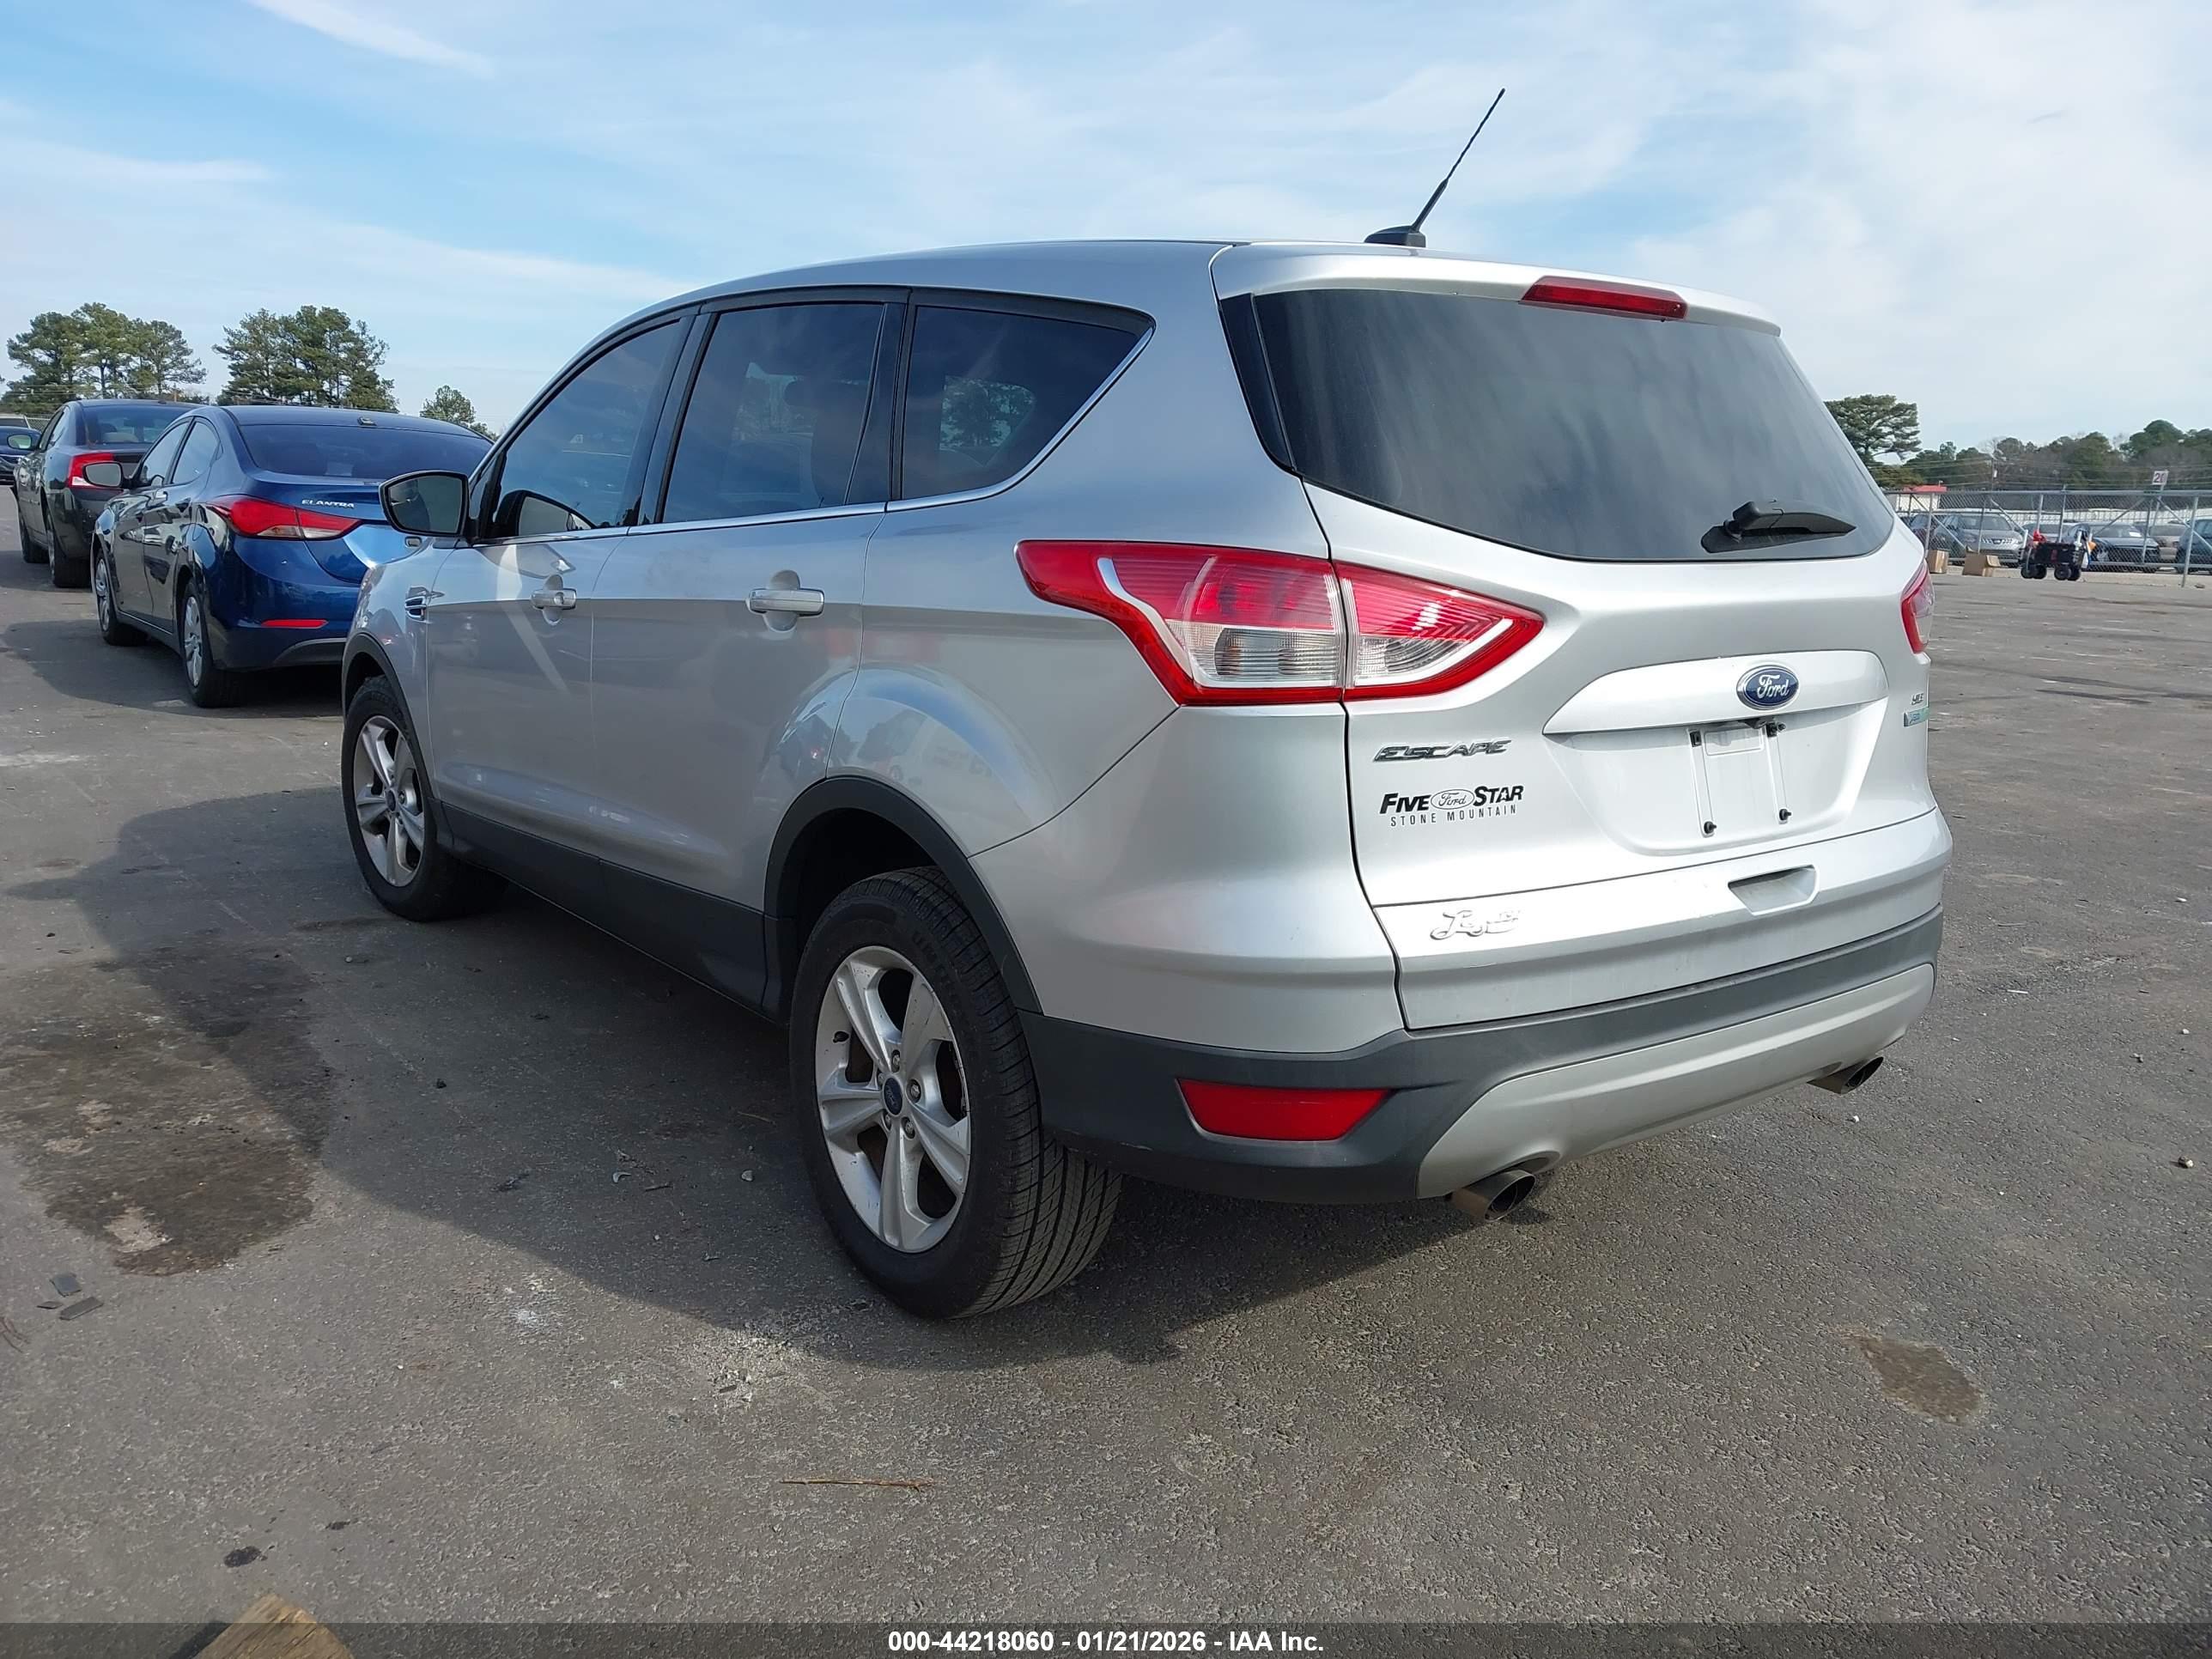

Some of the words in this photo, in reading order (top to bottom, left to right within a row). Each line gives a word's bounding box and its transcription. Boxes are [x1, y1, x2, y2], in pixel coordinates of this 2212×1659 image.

[301, 499, 356, 509] ELANTRA
[1757, 674, 1790, 699] Ford
[1374, 739, 1512, 763] ESCAPE
[1379, 792, 1432, 815] FIVE
[1437, 792, 1468, 807] Ford
[1473, 785, 1525, 807] STAR
[1390, 812, 1437, 827] STONE
[1446, 804, 1517, 822] MOUNTAIN
